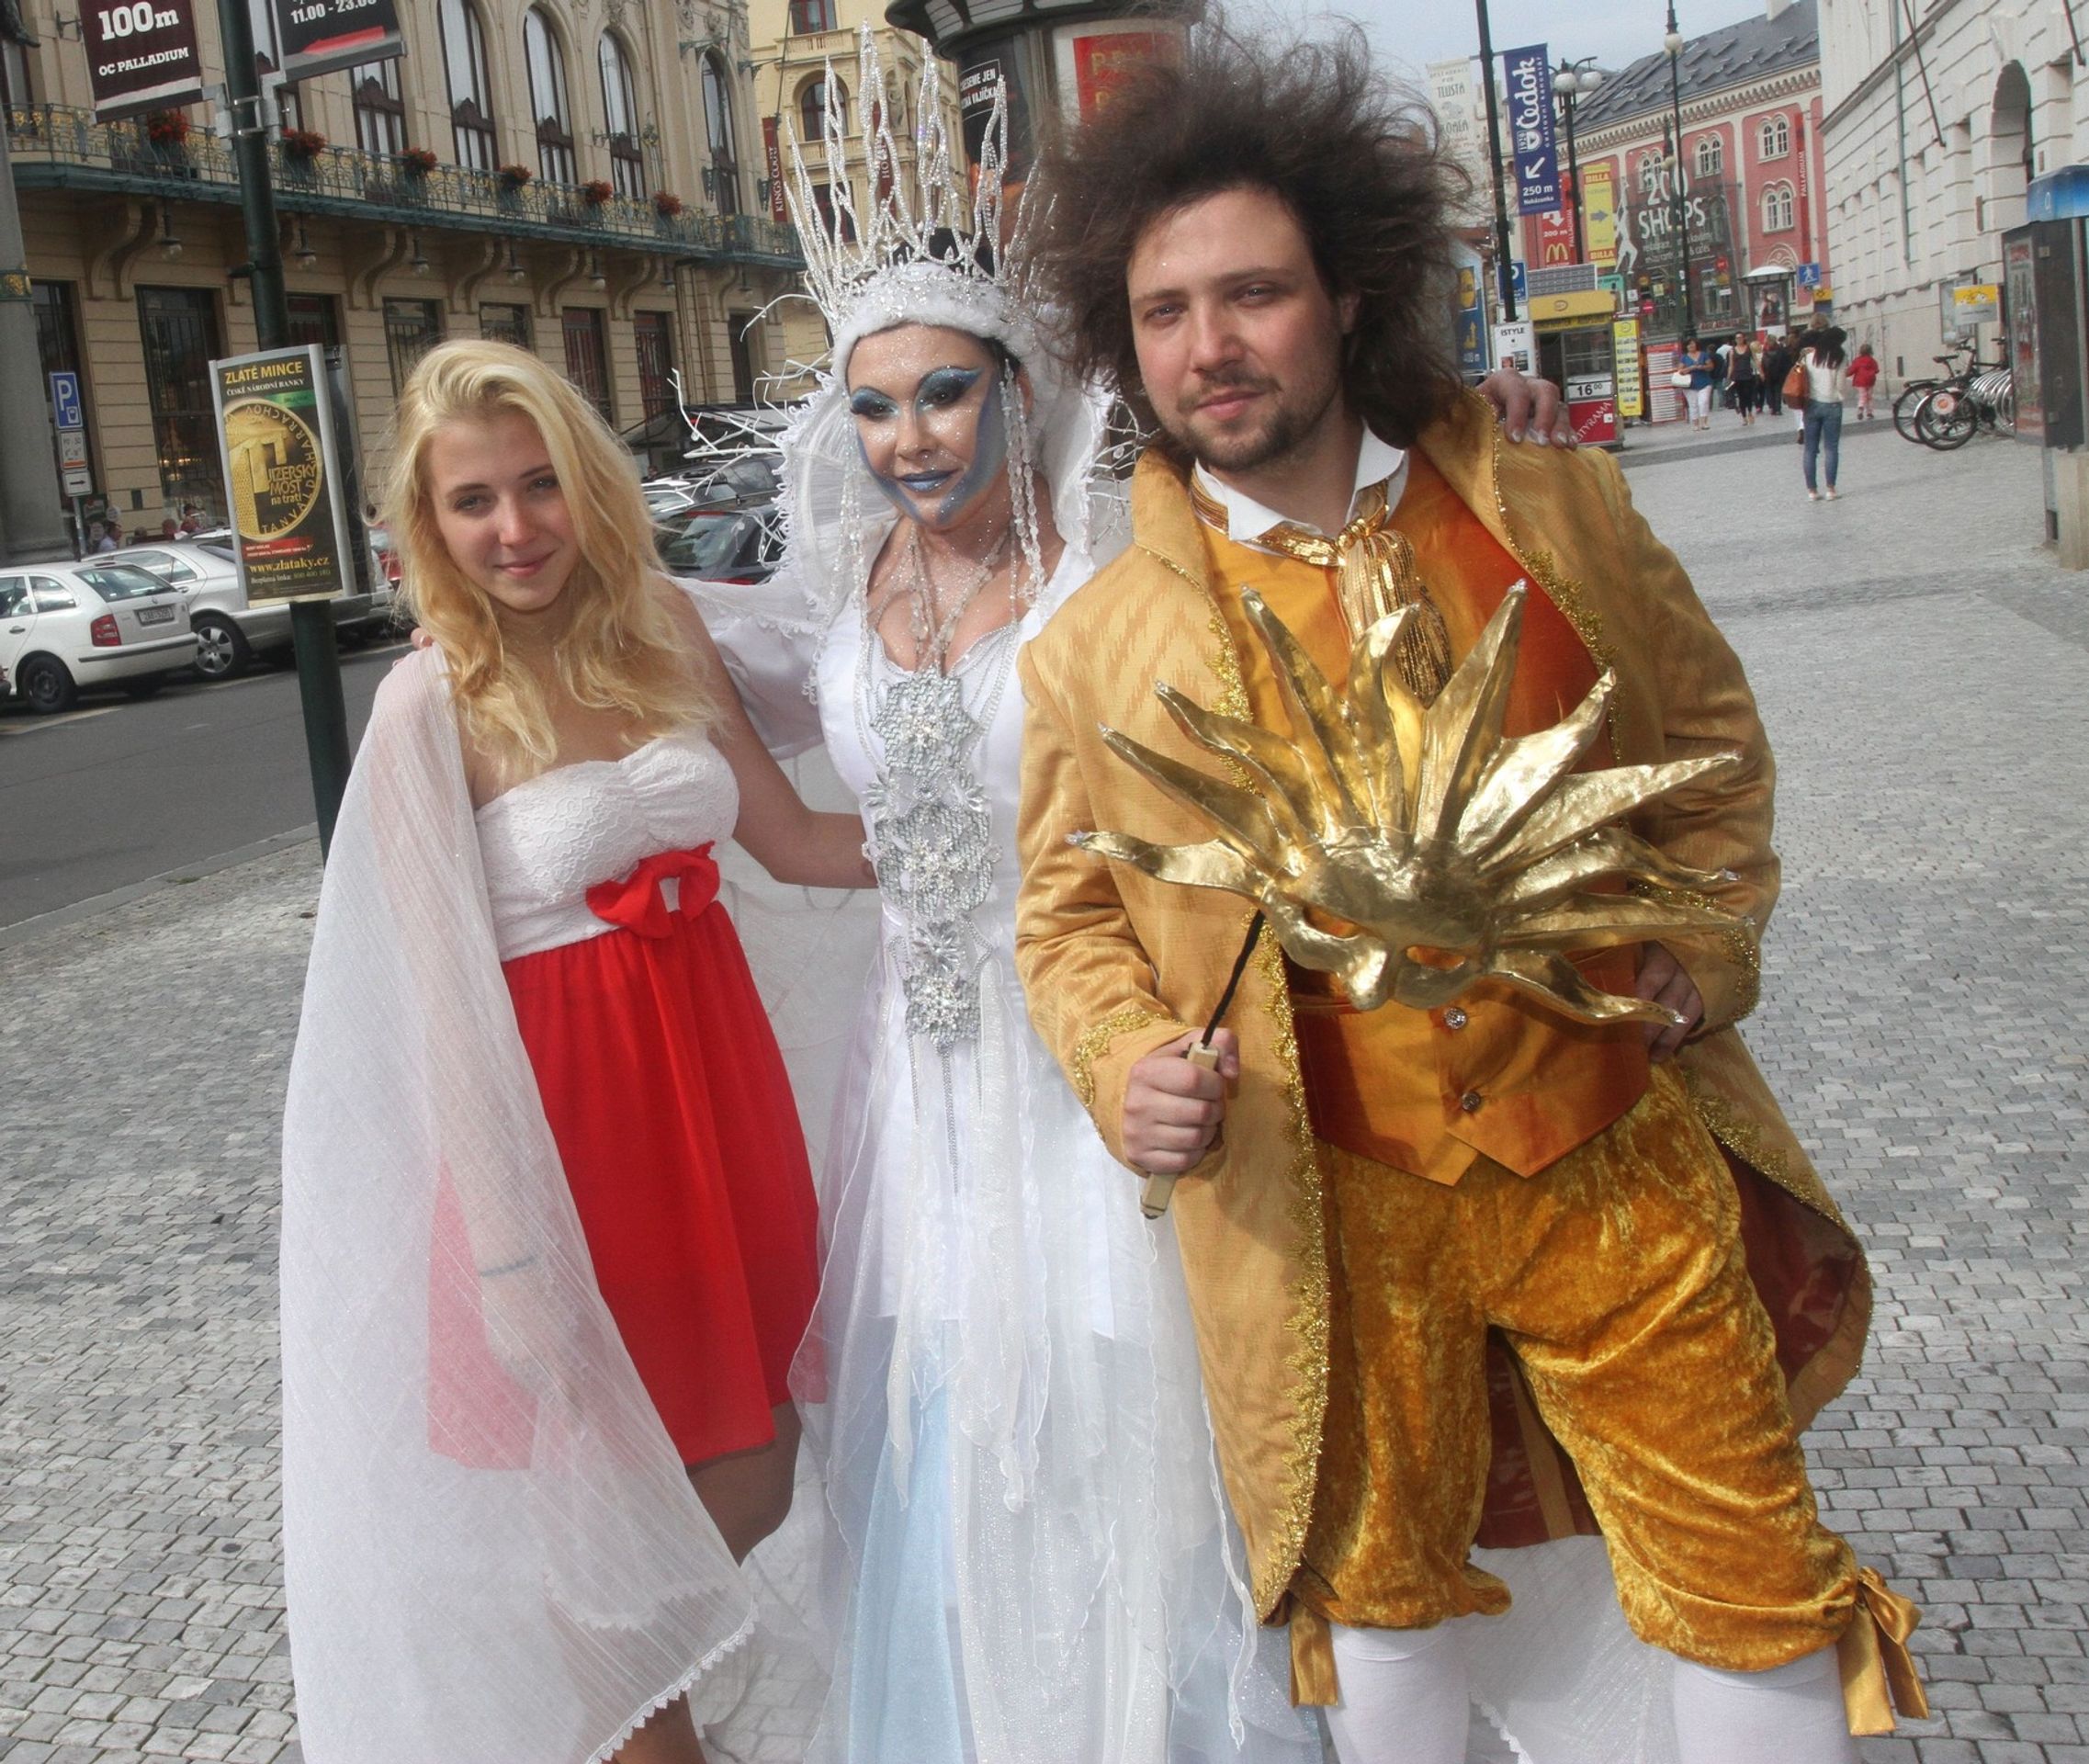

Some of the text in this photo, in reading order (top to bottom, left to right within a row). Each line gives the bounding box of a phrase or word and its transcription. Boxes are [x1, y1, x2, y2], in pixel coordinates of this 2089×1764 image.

[98, 2, 179, 40] 100m
[291, 4, 326, 24] 11.00
[99, 47, 189, 75] OC PALLADIUM
[1512, 57, 1541, 130] Čedok
[1586, 173, 1609, 183] BILLA
[773, 180, 784, 212] KINGS
[1522, 185, 1553, 197] 250 m
[1590, 250, 1614, 260] BILLA
[225, 361, 303, 384] ZLATÉ MINCE
[57, 379, 73, 411] P
[227, 386, 245, 396] ČESKÉ
[246, 381, 277, 393] NÁRODNÍ
[270, 479, 302, 496] MOST
[262, 480, 315, 534] TANVALD
[271, 497, 281, 505] na
[249, 557, 330, 573] www.zlataky.cz
